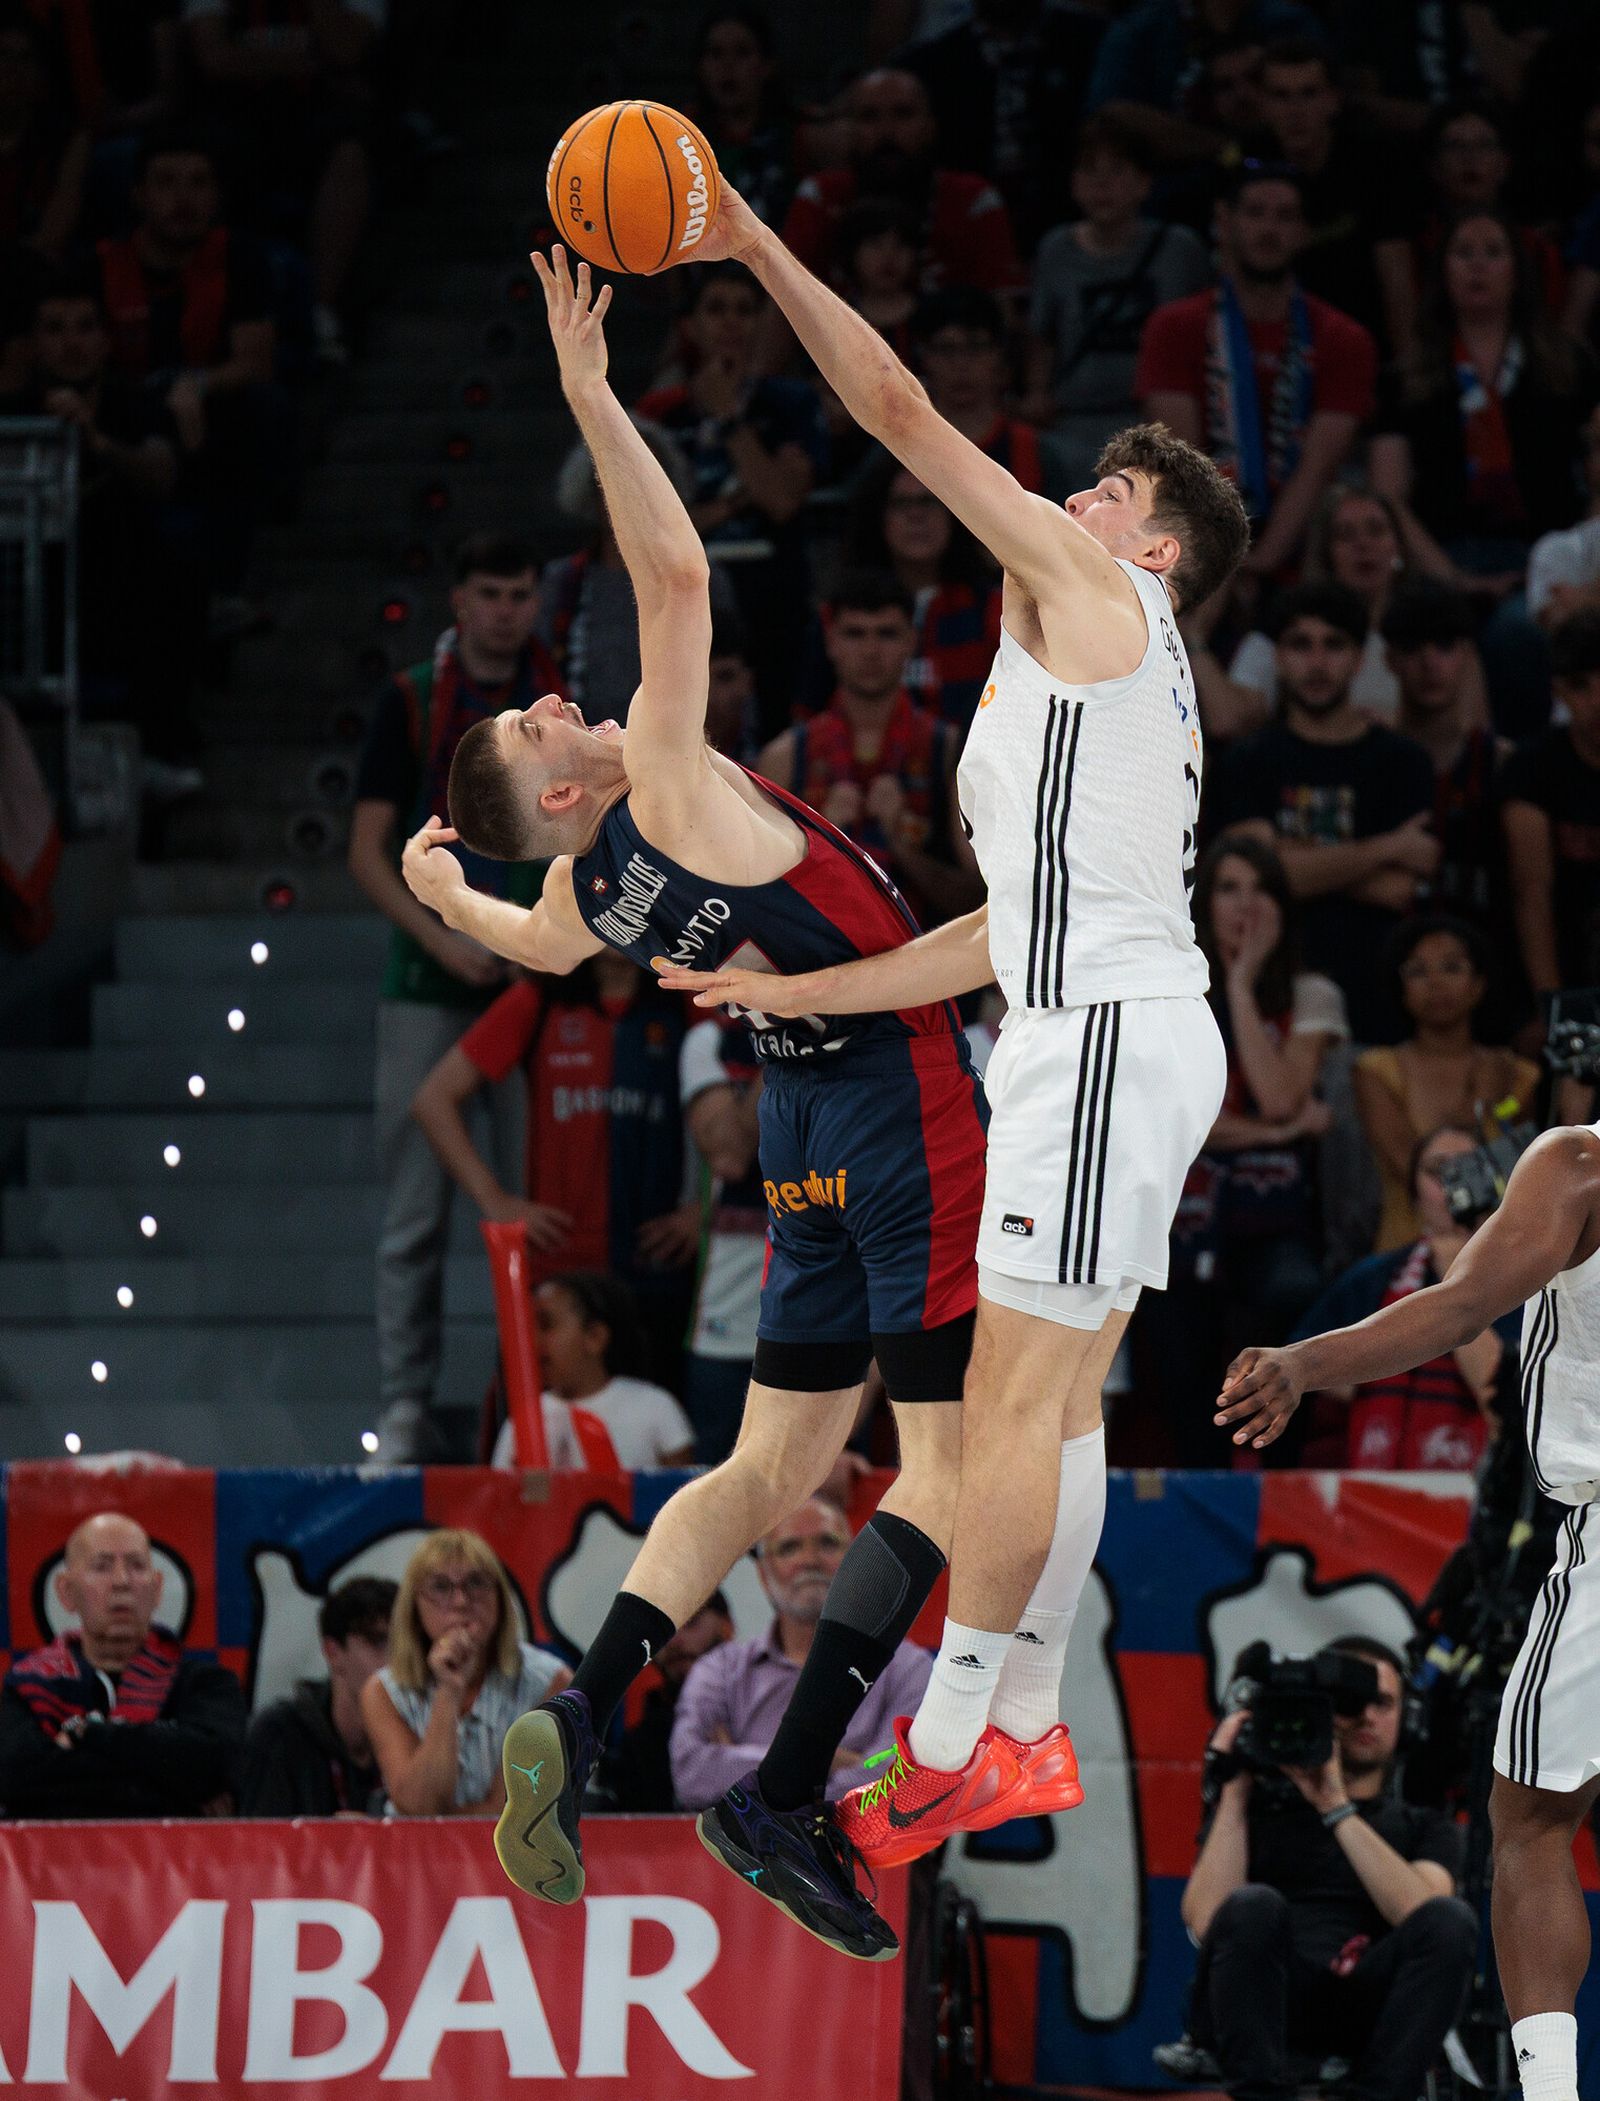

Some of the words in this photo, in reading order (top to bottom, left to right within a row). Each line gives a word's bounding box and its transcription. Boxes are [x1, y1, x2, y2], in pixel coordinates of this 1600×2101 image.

[569, 176, 584, 222] acb
[676, 134, 708, 250] Wilson
[1003, 1221, 1027, 1234] acb
[949, 1657, 986, 1670] adidas
[0, 1895, 757, 2084] MBAR
